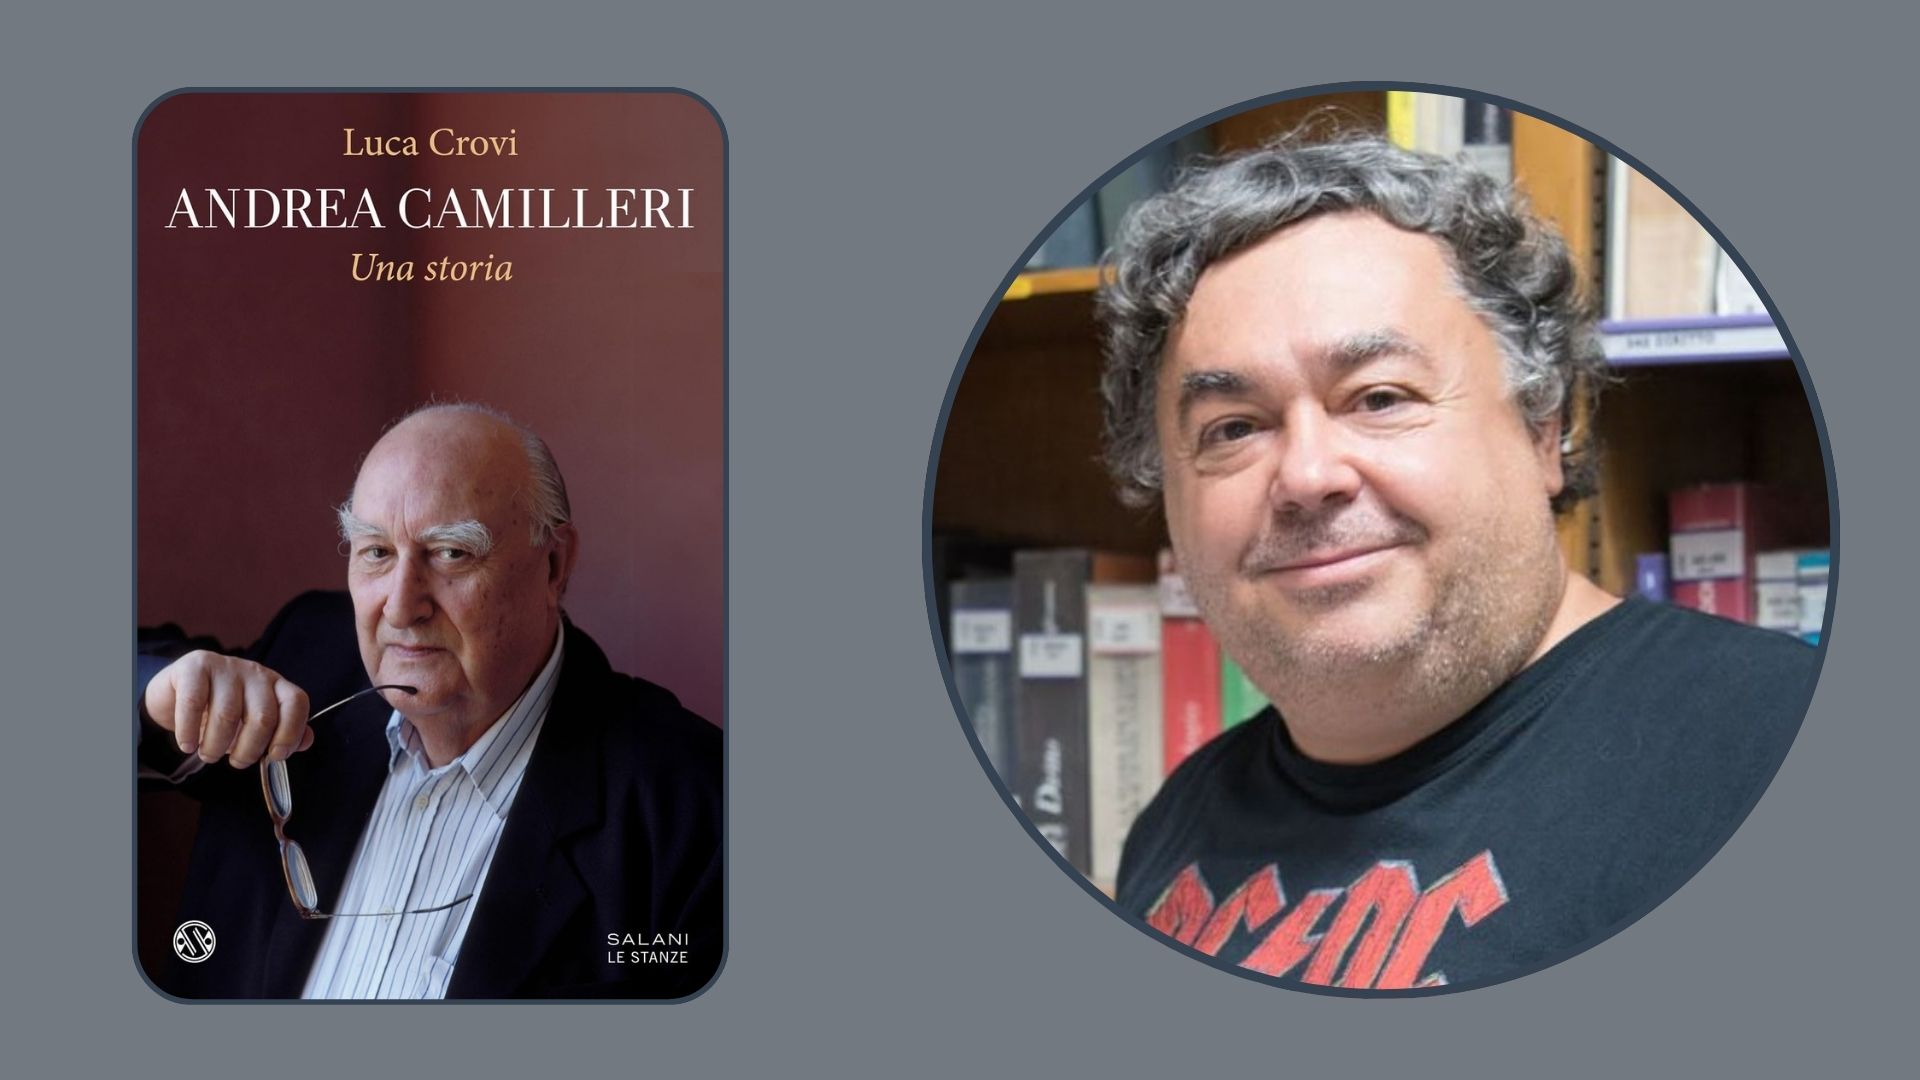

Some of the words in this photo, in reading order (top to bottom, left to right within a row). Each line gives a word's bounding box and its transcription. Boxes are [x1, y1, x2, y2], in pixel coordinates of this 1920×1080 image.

[343, 128, 419, 156] Luca
[429, 128, 519, 156] Crovi
[164, 187, 386, 230] ANDREA
[398, 187, 696, 230] CAMILLERI
[350, 253, 415, 282] Una
[423, 253, 514, 282] storia
[607, 932, 690, 946] SALANI
[607, 950, 627, 964] LE
[630, 950, 689, 964] STANZE
